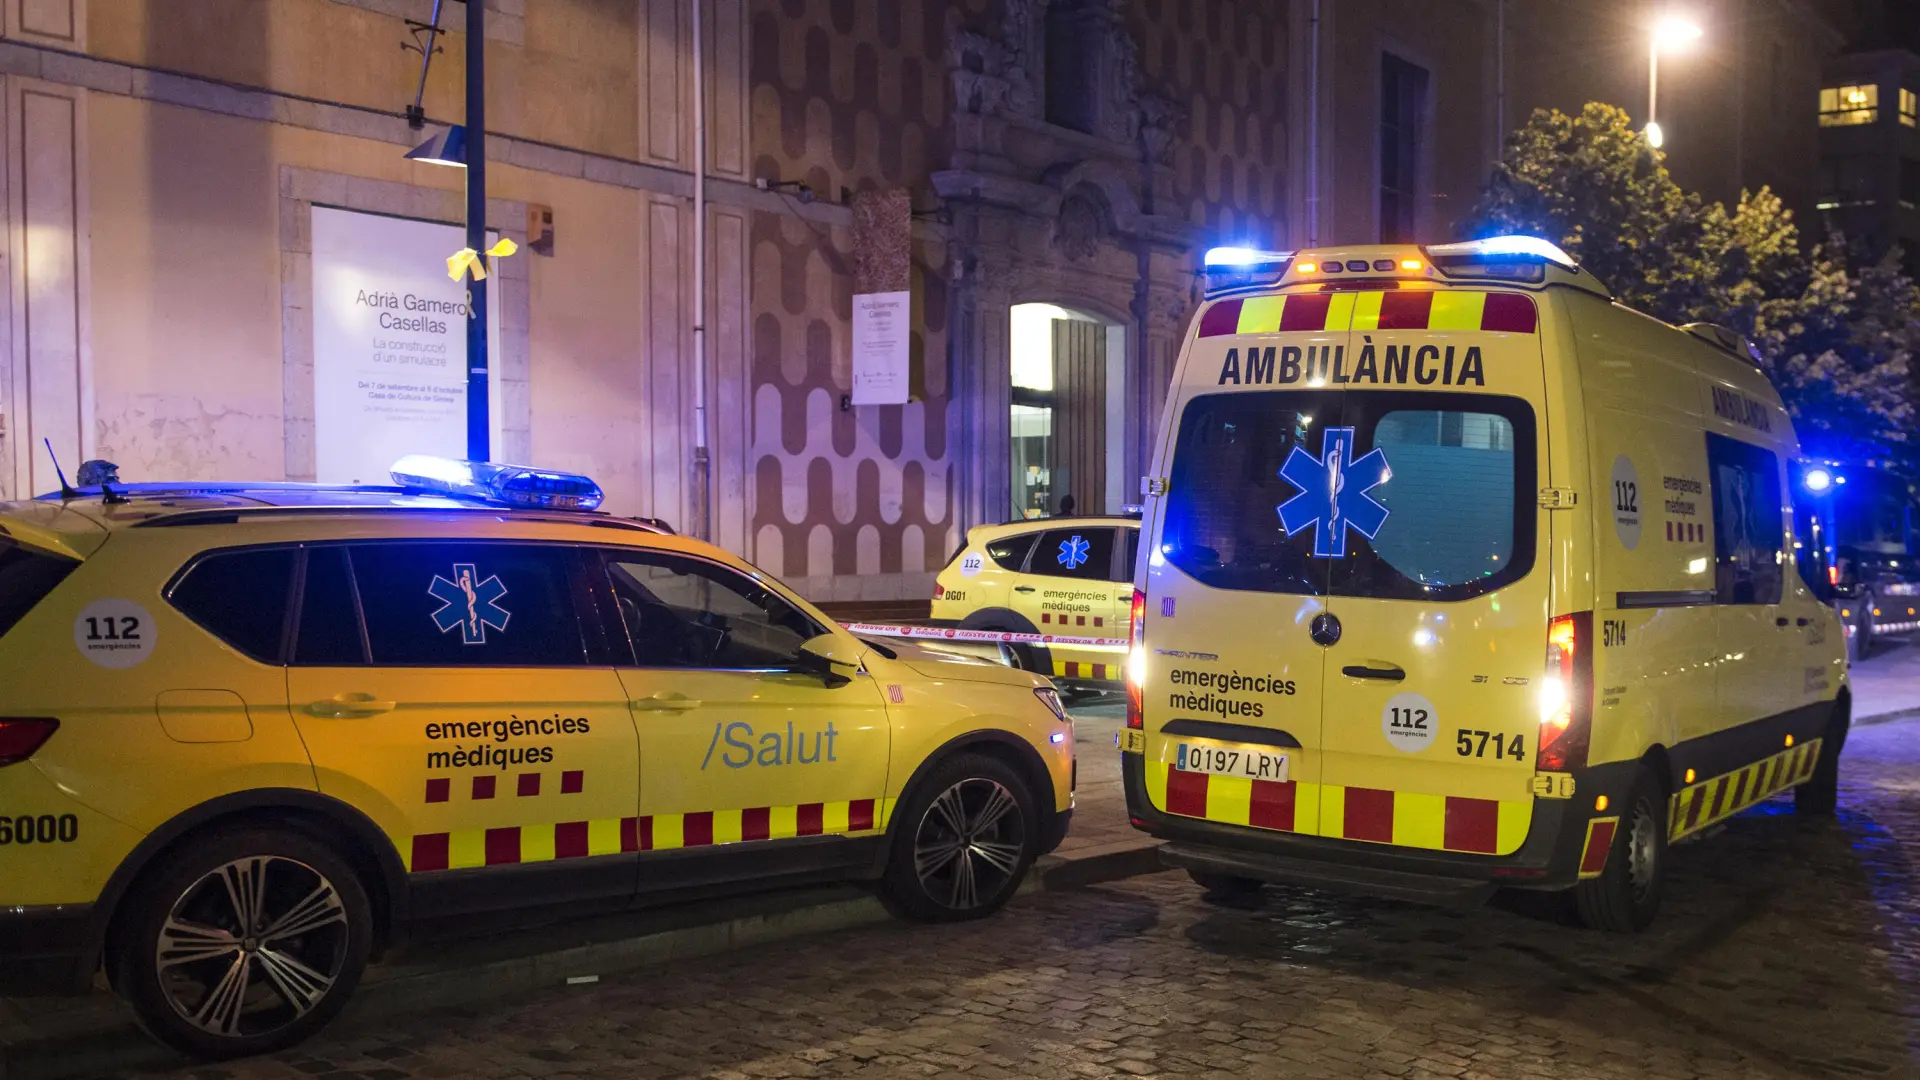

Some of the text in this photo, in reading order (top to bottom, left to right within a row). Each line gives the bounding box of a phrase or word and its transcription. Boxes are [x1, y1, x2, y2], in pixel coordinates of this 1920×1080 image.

[356, 289, 467, 316] Adrià Gamero
[380, 312, 446, 334] Casellas
[373, 338, 446, 354] La construcció
[399, 354, 446, 367] simulacre
[1218, 336, 1485, 386] AMBULÀNCIA
[1616, 480, 1637, 512] 112
[964, 560, 980, 568] 112
[946, 591, 966, 600] DG01
[1042, 601, 1090, 613] mèdiques
[1044, 590, 1107, 601] emergències
[86, 616, 140, 640] 112
[1604, 620, 1626, 647] 5714
[88, 642, 142, 650] emergències
[1170, 670, 1296, 695] emergències
[1170, 691, 1264, 718] mèdiques
[426, 714, 590, 742] emergències
[1391, 708, 1428, 729] 112
[427, 745, 553, 770] mèdiques
[1457, 729, 1525, 761] 5714
[1190, 748, 1239, 772] 0197
[1246, 754, 1284, 778] LRY
[0, 814, 78, 845] 6000
